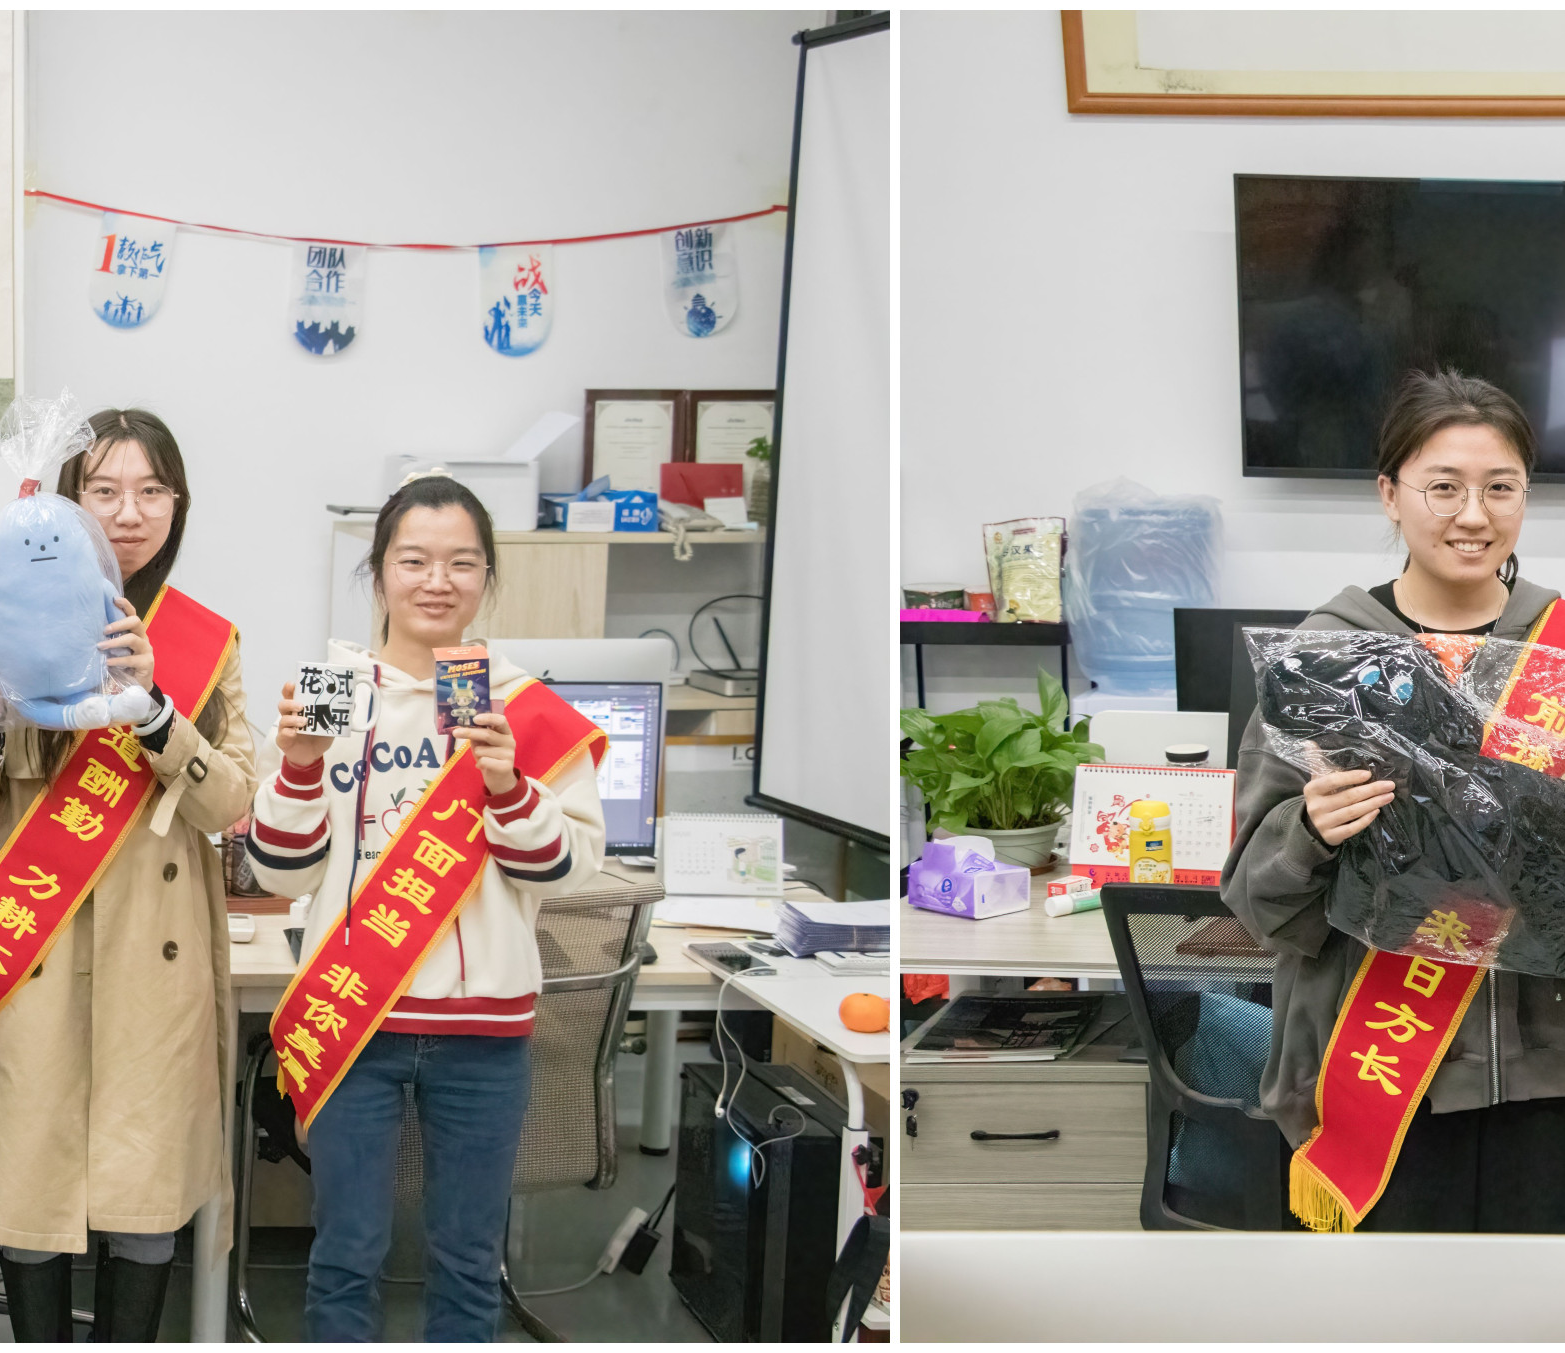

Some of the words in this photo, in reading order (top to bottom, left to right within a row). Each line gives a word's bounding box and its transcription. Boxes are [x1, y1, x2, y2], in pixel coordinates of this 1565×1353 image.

[306, 245, 347, 270] 团队
[305, 270, 346, 293] 合作
[447, 661, 480, 674] MOSES
[360, 799, 485, 948] 门面担当
[1350, 909, 1472, 1096] 来日方长
